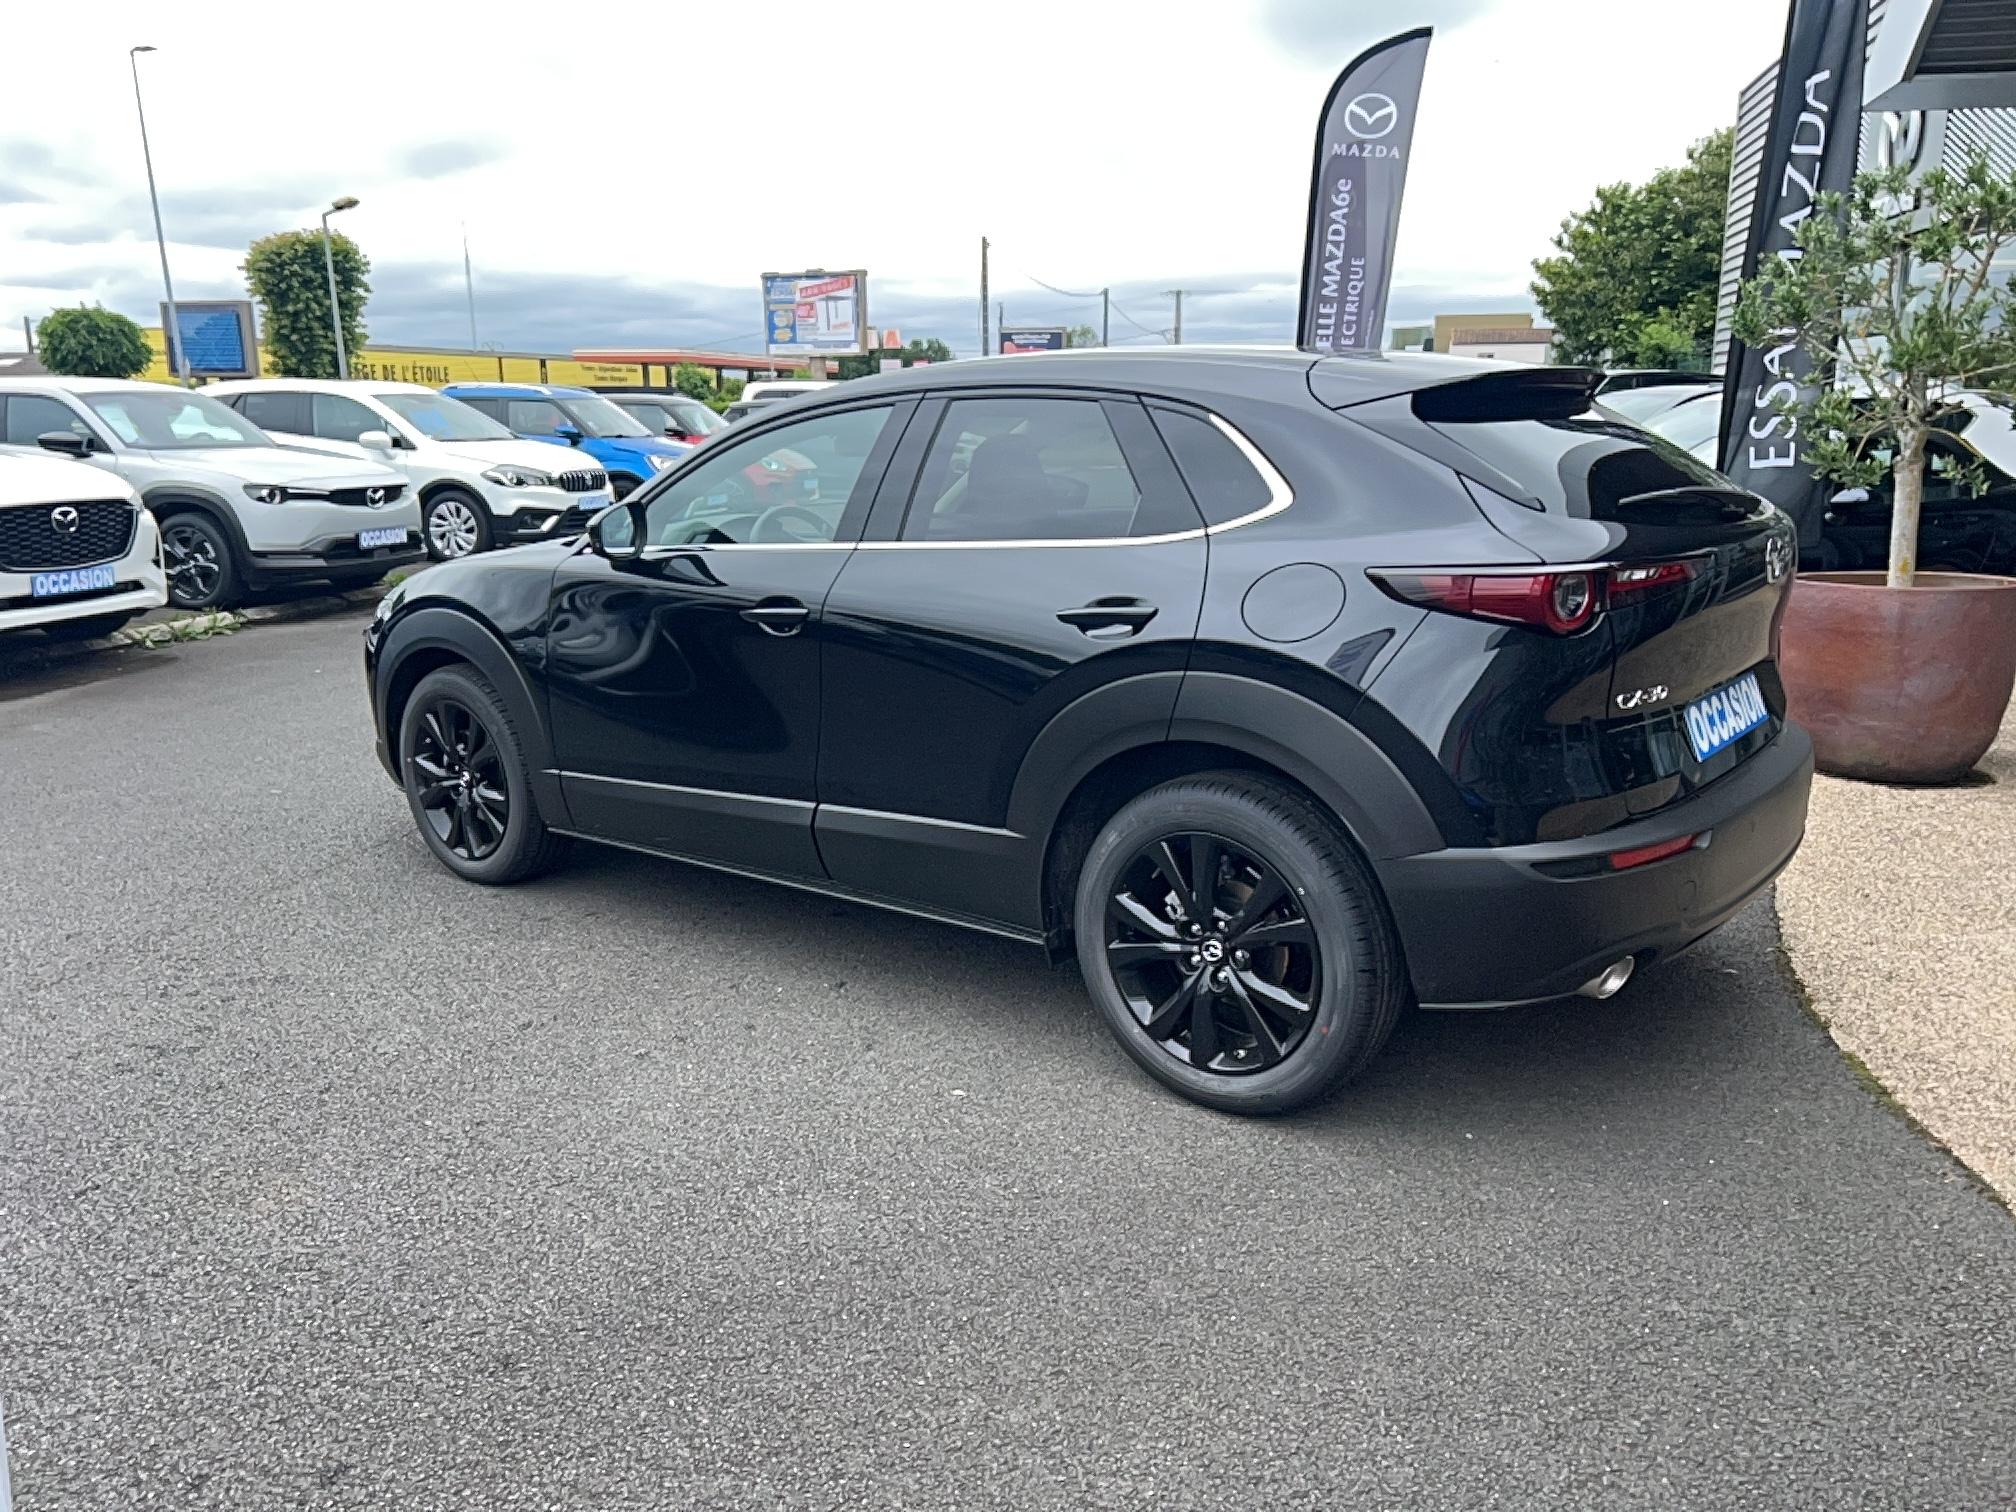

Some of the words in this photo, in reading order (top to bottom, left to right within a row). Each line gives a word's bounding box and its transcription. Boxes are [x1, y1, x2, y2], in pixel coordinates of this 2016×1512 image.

[1332, 143, 1400, 159] MAZDA
[1321, 178, 1352, 297] MAZDA6e
[382, 364, 397, 380] DE
[361, 528, 407, 548] OCCASION
[36, 568, 114, 596] OCCASION
[1617, 685, 1668, 709] CX-30
[1690, 674, 1768, 753] OCCASION
